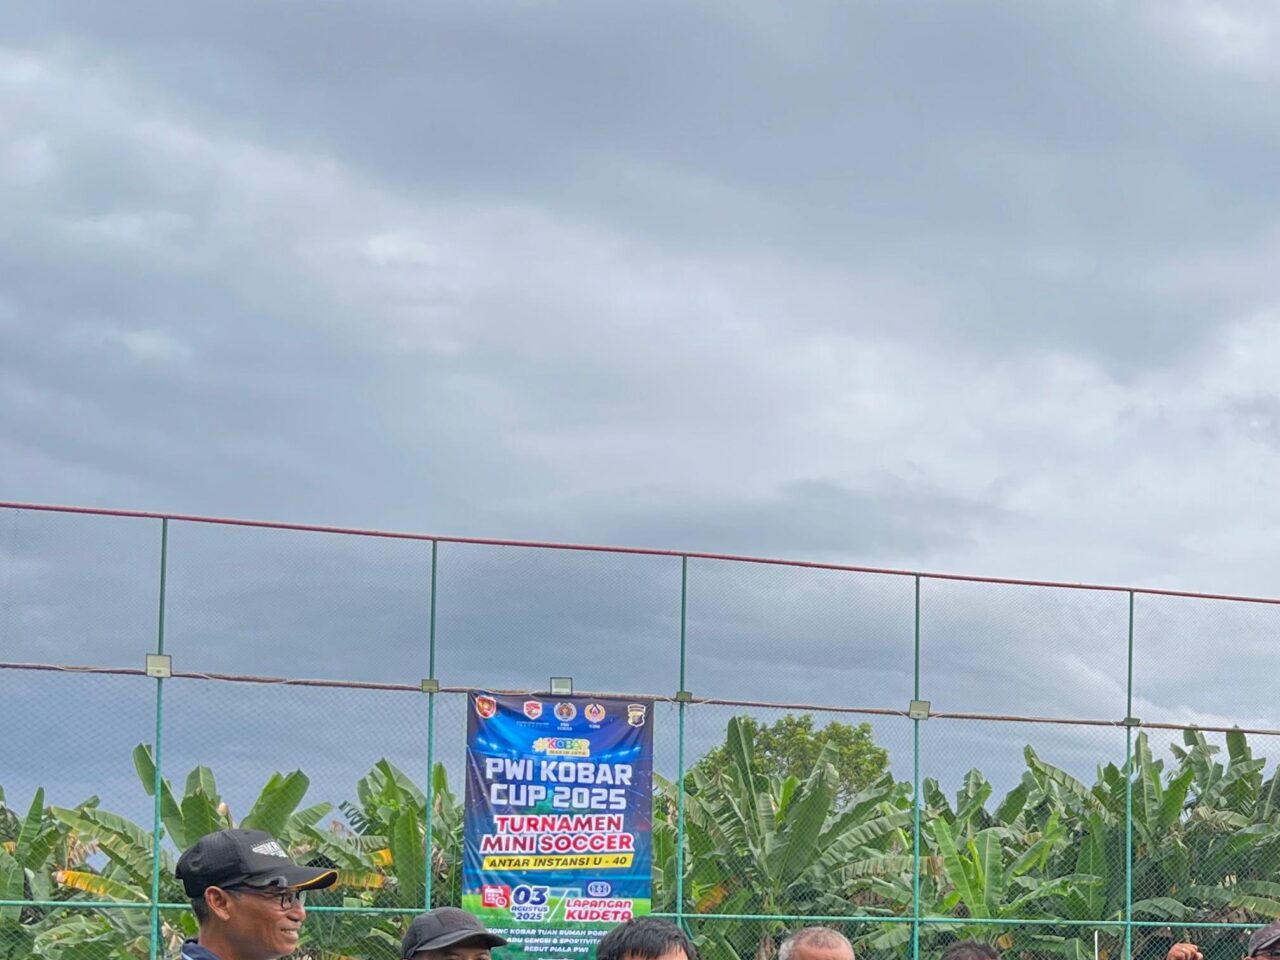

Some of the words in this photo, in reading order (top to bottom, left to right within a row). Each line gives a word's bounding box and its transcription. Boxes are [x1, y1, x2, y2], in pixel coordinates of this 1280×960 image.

[485, 757, 533, 781] PWI
[540, 760, 632, 785] KOBAR
[490, 783, 546, 806] CUP
[552, 786, 627, 810] 2025
[494, 814, 624, 834] TURNAMEN
[481, 835, 536, 853] MINI
[539, 833, 634, 852] SOCCER
[489, 858, 530, 868] ANTAR
[533, 858, 589, 867] INSTANSI
[593, 857, 602, 866] U
[612, 856, 627, 865] 40
[512, 885, 549, 906] 03
[516, 912, 543, 920] 2025
[565, 910, 632, 921] KUDETA
